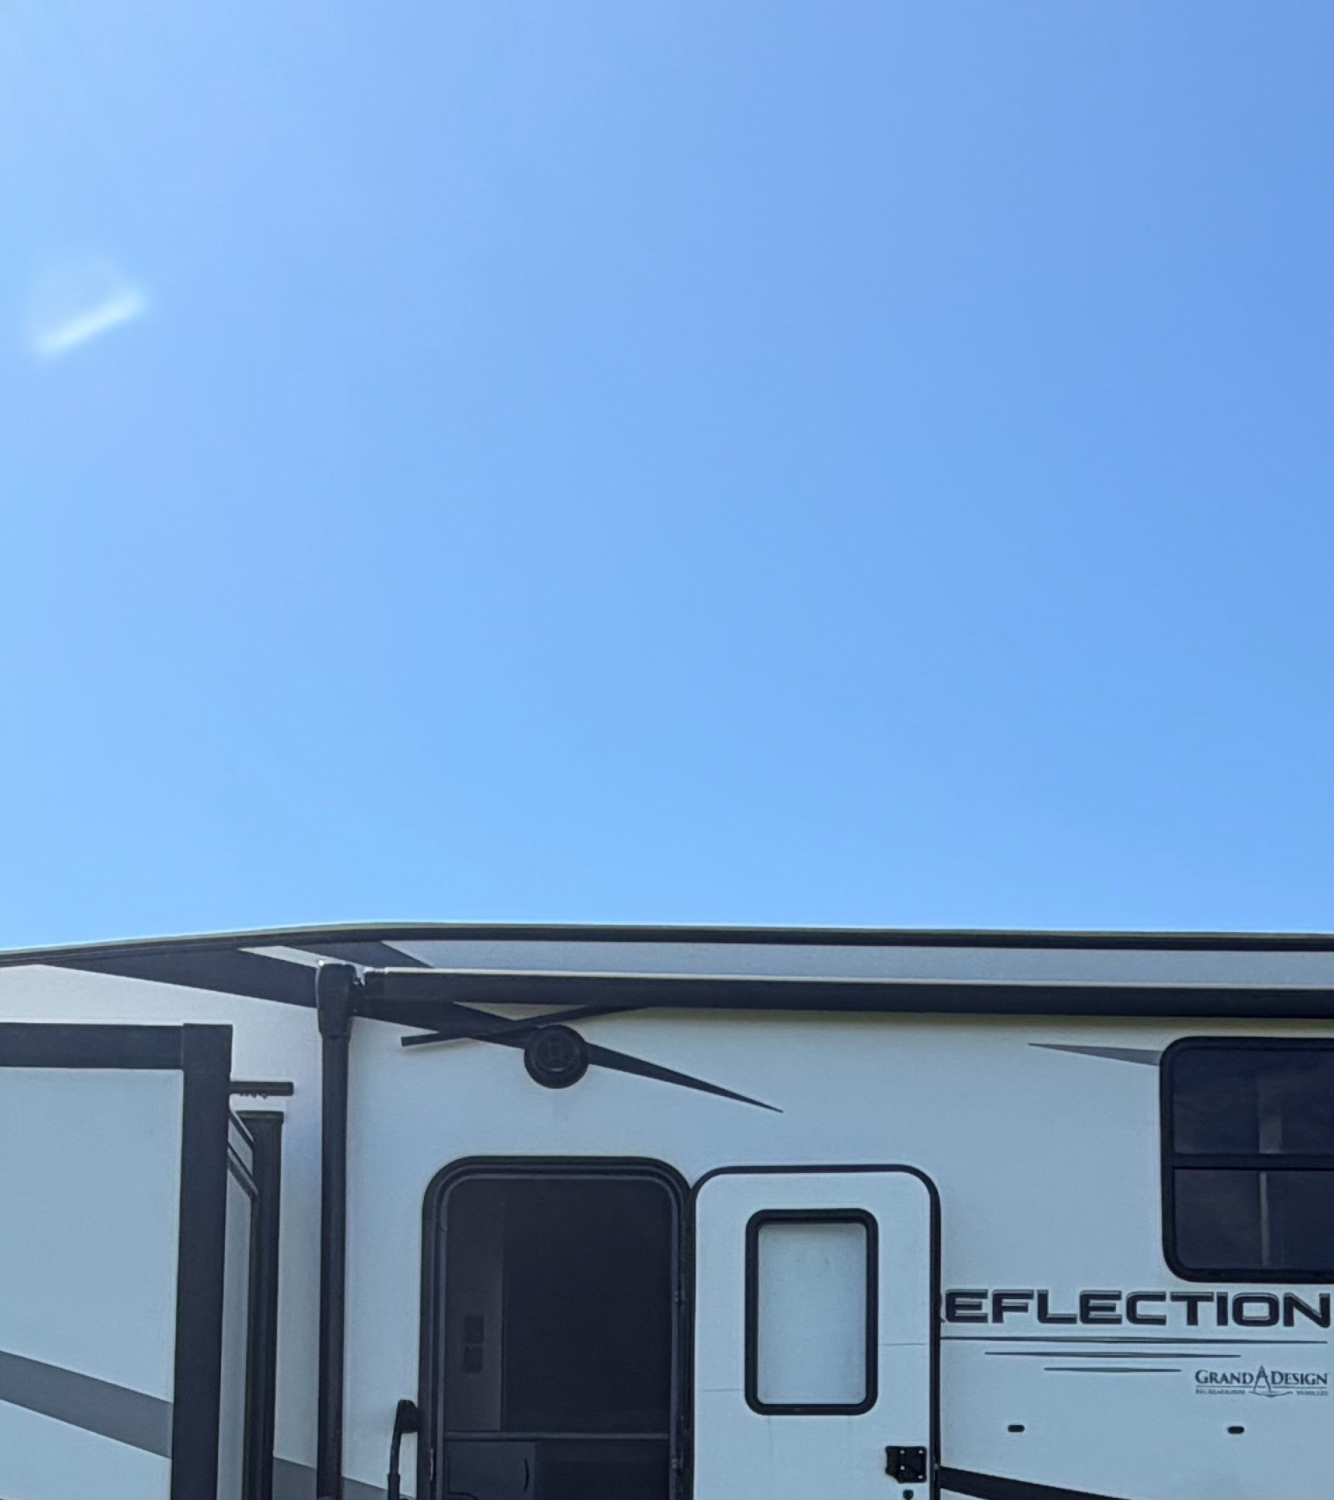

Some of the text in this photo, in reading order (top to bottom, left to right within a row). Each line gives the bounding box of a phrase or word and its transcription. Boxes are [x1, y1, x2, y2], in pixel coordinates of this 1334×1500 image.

[940, 1288, 1331, 1328] EFLECTION
[1195, 1369, 1328, 1385] GRAND DESIGN
